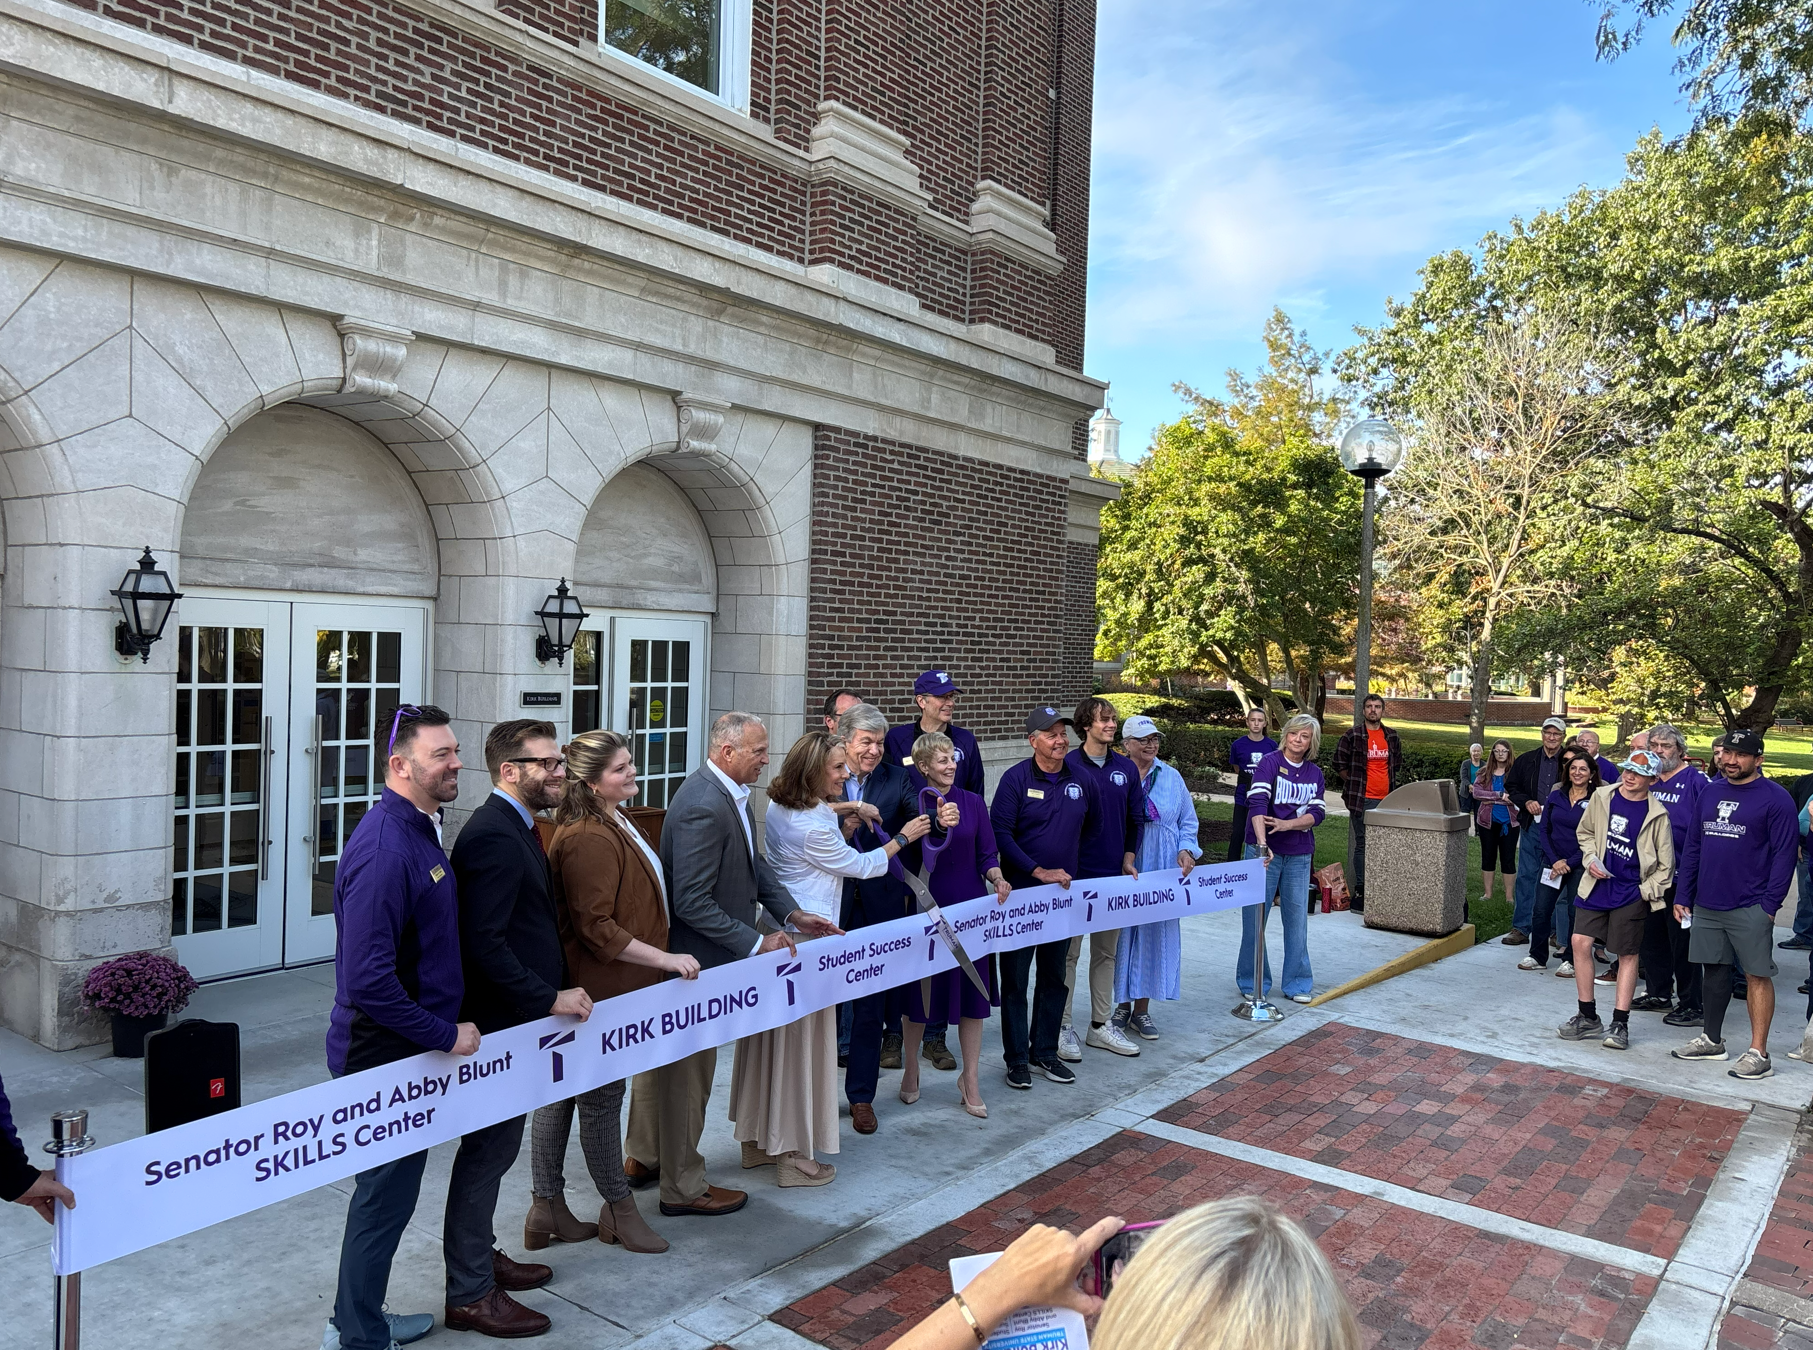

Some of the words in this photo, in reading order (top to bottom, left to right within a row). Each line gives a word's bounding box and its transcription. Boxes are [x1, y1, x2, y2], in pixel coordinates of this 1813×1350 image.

[1366, 749, 1389, 758] RUMA
[1702, 821, 1747, 834] TRUMAN
[1197, 874, 1222, 887] Student
[1223, 873, 1249, 884] Success
[1107, 894, 1131, 912] KIRK
[1132, 888, 1175, 908] BUILDING
[1214, 887, 1235, 900] Center
[953, 914, 988, 934] Senator
[989, 909, 1007, 924] Roy
[1008, 903, 1026, 918] and
[1027, 900, 1050, 916] Abby
[1051, 895, 1074, 911] Blunt
[982, 923, 1014, 943] SKILLS
[1015, 919, 1044, 935] Center
[818, 945, 866, 972] Student
[868, 935, 912, 958] Success
[845, 963, 886, 985] Center
[601, 1017, 655, 1056] KIRK
[661, 985, 759, 1036] BUILDING
[144, 1132, 265, 1187] Senator
[273, 1113, 325, 1146] Roy
[331, 1091, 382, 1125] and
[387, 1073, 452, 1109] Abby
[458, 1051, 513, 1086] Blunt
[255, 1133, 348, 1183] SKILLS
[354, 1107, 436, 1148] Center
[1020, 1335, 1038, 1344] STATE
[1039, 1330, 1065, 1340] TRUMAN
